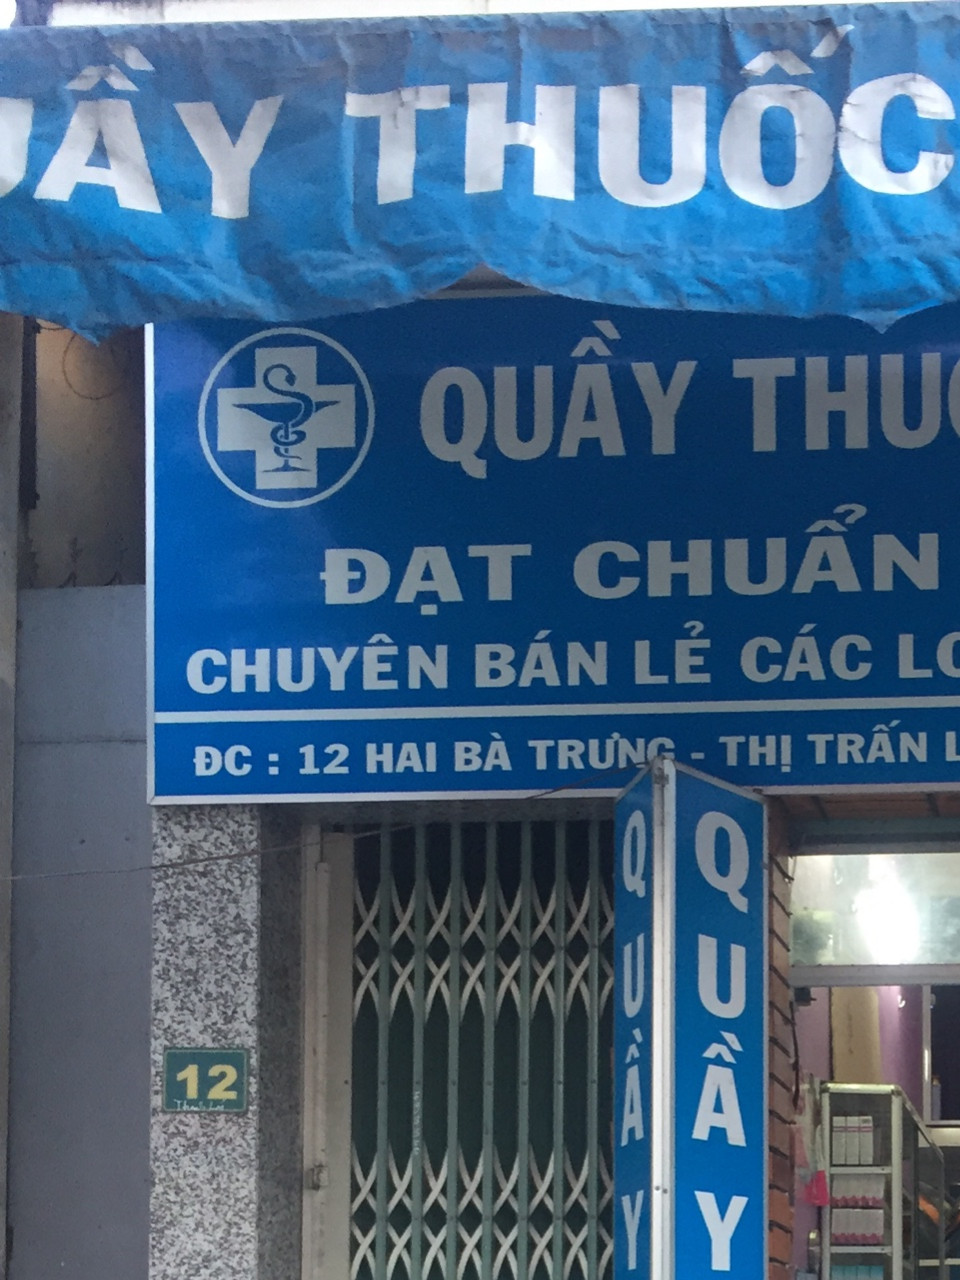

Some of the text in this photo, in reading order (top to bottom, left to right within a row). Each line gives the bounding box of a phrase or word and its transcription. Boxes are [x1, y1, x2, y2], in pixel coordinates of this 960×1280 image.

[345, 24, 955, 210] THUỐC
[419, 320, 698, 479] QUẦY
[320, 544, 532, 615] ĐẠT
[573, 503, 940, 599] CHUẨN
[186, 632, 449, 694] CHUYÊN
[474, 629, 608, 688] BÁN
[634, 620, 711, 685] LẺ
[740, 623, 873, 683] CÁC
[193, 746, 253, 777] ĐC
[299, 744, 349, 773] 12
[366, 743, 437, 773] HAI
[453, 732, 513, 773] BÀ
[527, 732, 675, 771] TRƯNG
[718, 735, 792, 772] THỊ
[808, 720, 928, 764] TRẤN
[176, 1064, 238, 1099] 12
[622, 810, 646, 1270] QUẦY
[691, 810, 750, 1272] QUẦY
